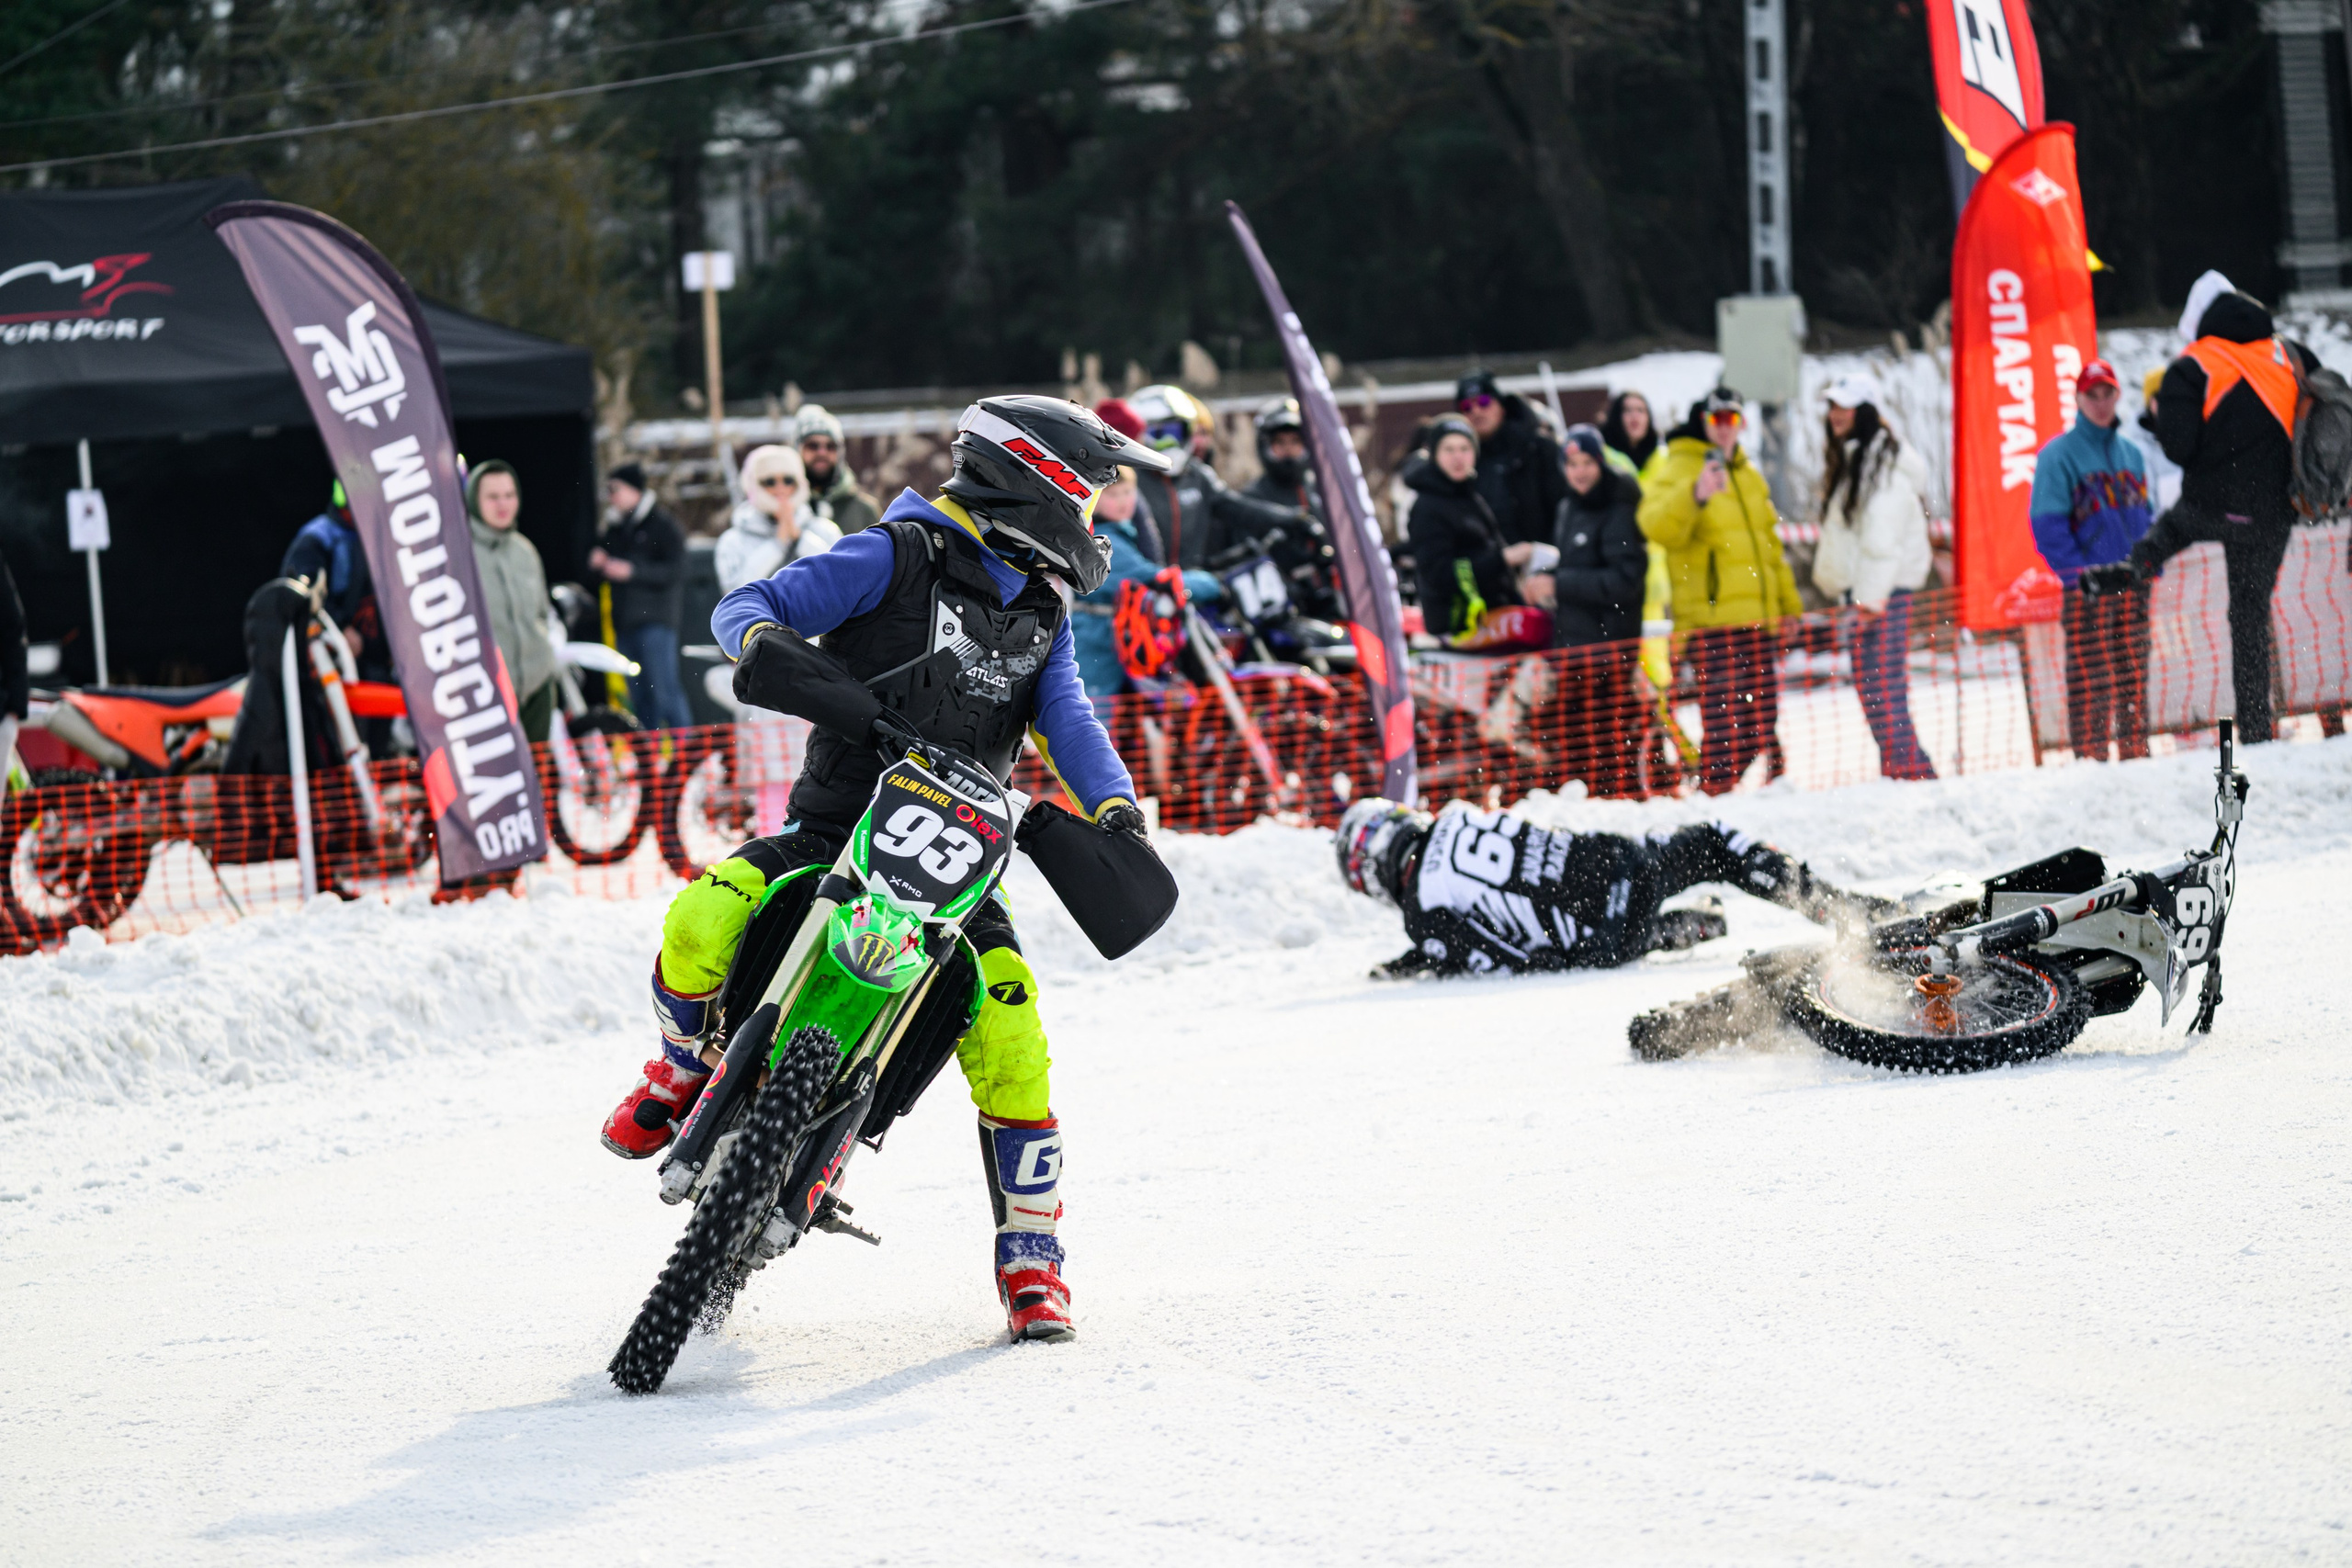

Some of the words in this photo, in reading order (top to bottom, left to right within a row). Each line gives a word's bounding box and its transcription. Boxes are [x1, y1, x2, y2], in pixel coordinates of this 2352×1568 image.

[1987, 268, 2038, 491] СПАРТАК
[1002, 437, 1091, 500] FMF
[966, 666, 1009, 688] ATLAS
[887, 773, 921, 793] FALIN
[916, 785, 953, 808] PAVEL
[956, 804, 1002, 844] Olex
[859, 829, 868, 865] Kawasaki
[873, 804, 984, 885] 93
[2176, 886, 2215, 961] 69
[997, 982, 1021, 1002] 7
